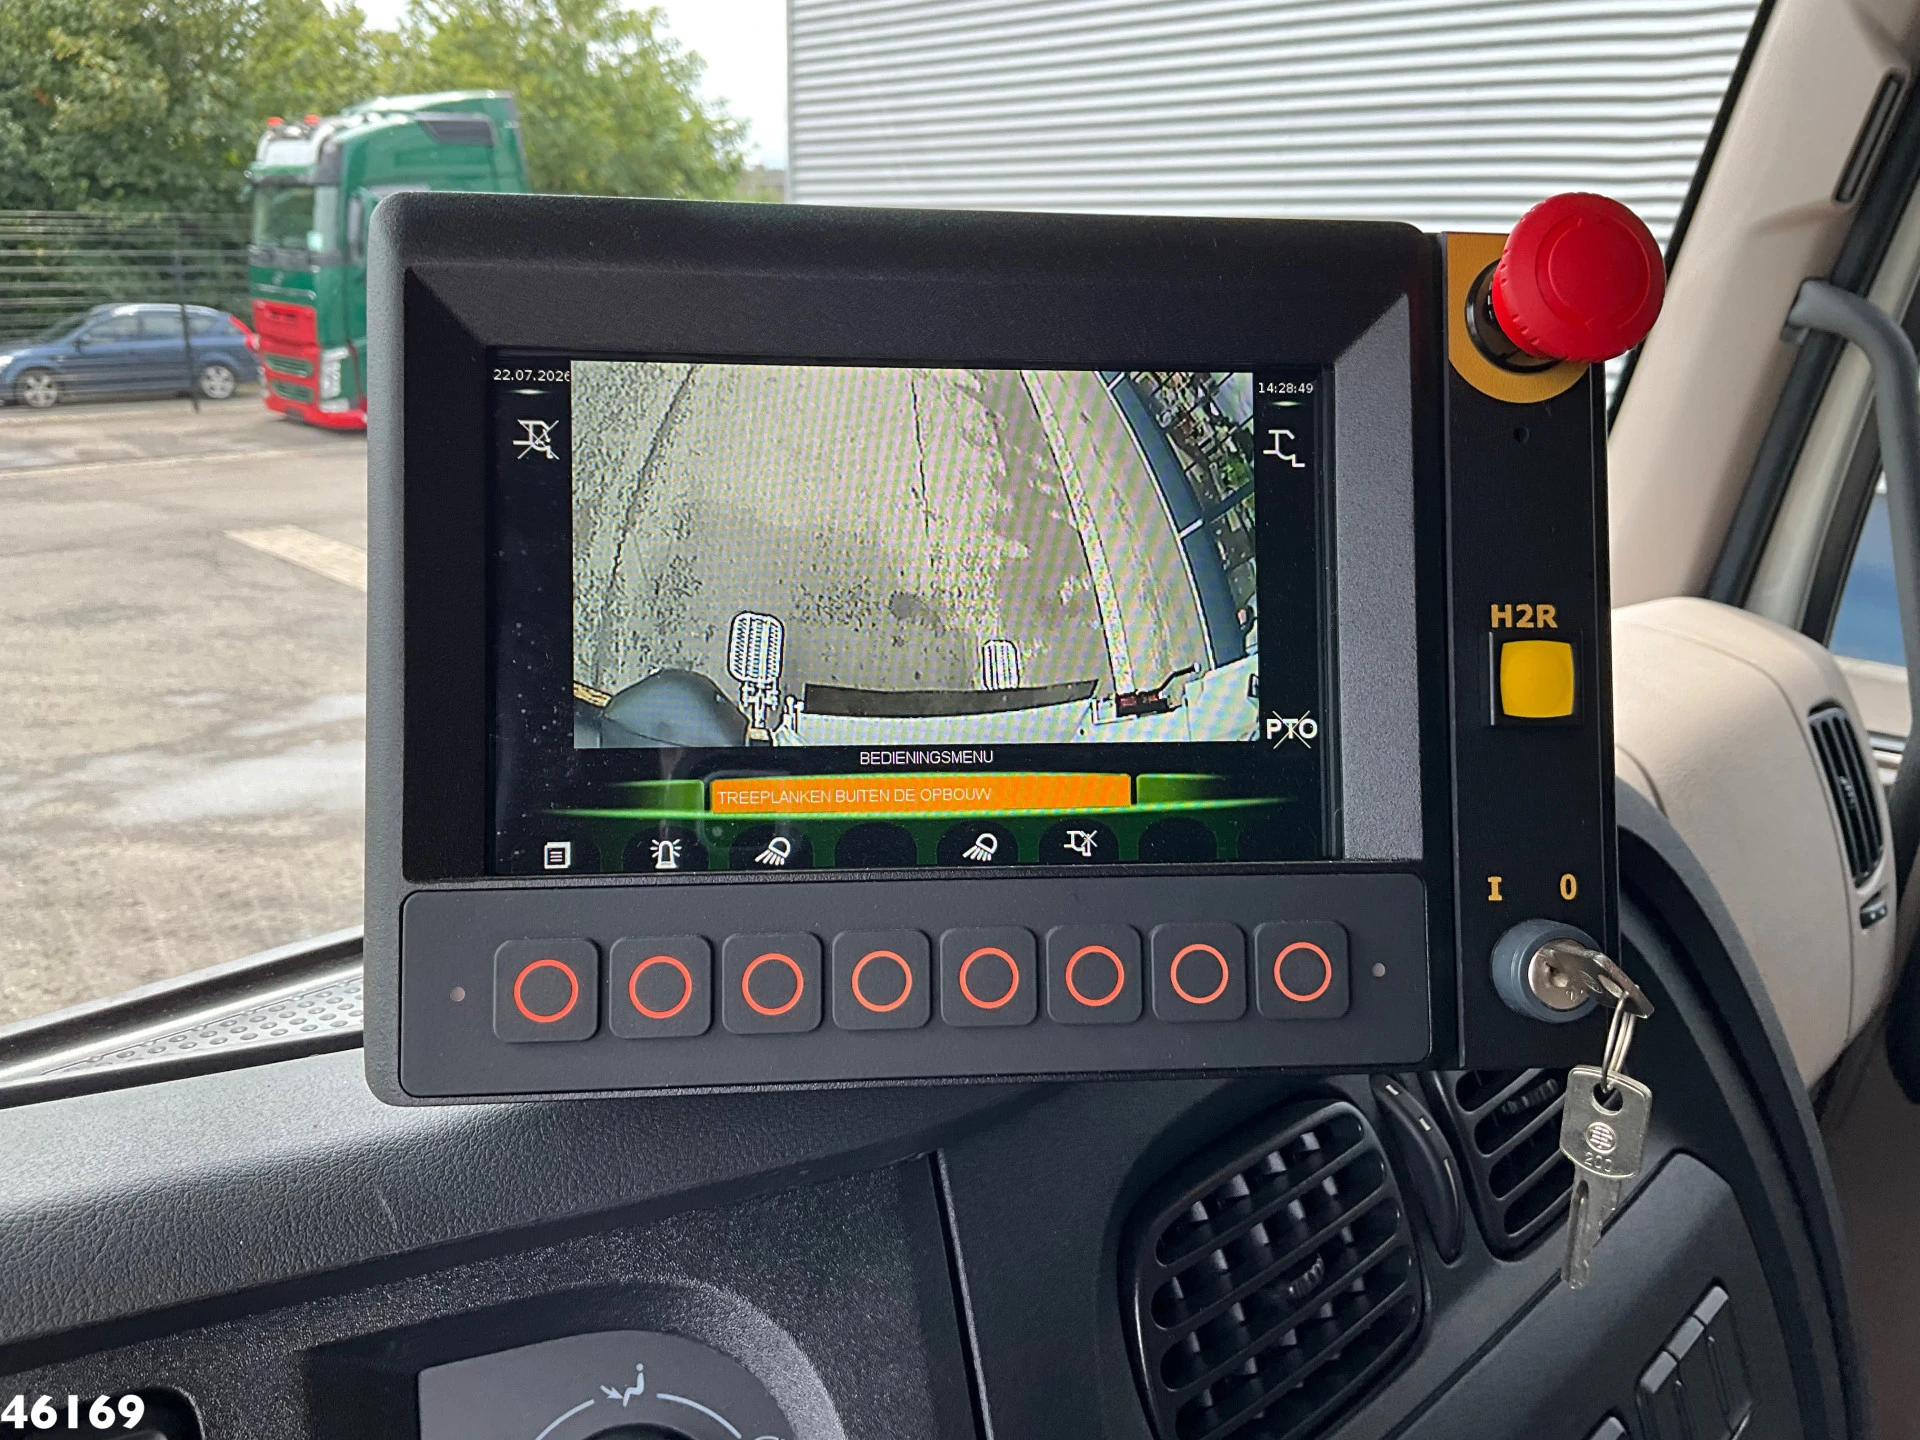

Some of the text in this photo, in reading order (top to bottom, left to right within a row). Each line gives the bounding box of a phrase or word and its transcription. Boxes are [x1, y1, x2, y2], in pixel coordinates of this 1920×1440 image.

[493, 368, 570, 382] 22.07.2026
[1258, 382, 1314, 394] 14:28:49
[1491, 603, 1558, 628] H2R
[1266, 718, 1318, 740] PTO
[860, 750, 994, 765] BEDIENINGSMENU
[717, 787, 992, 805] TREEPLANKEN BUITEN DE OPBOUW
